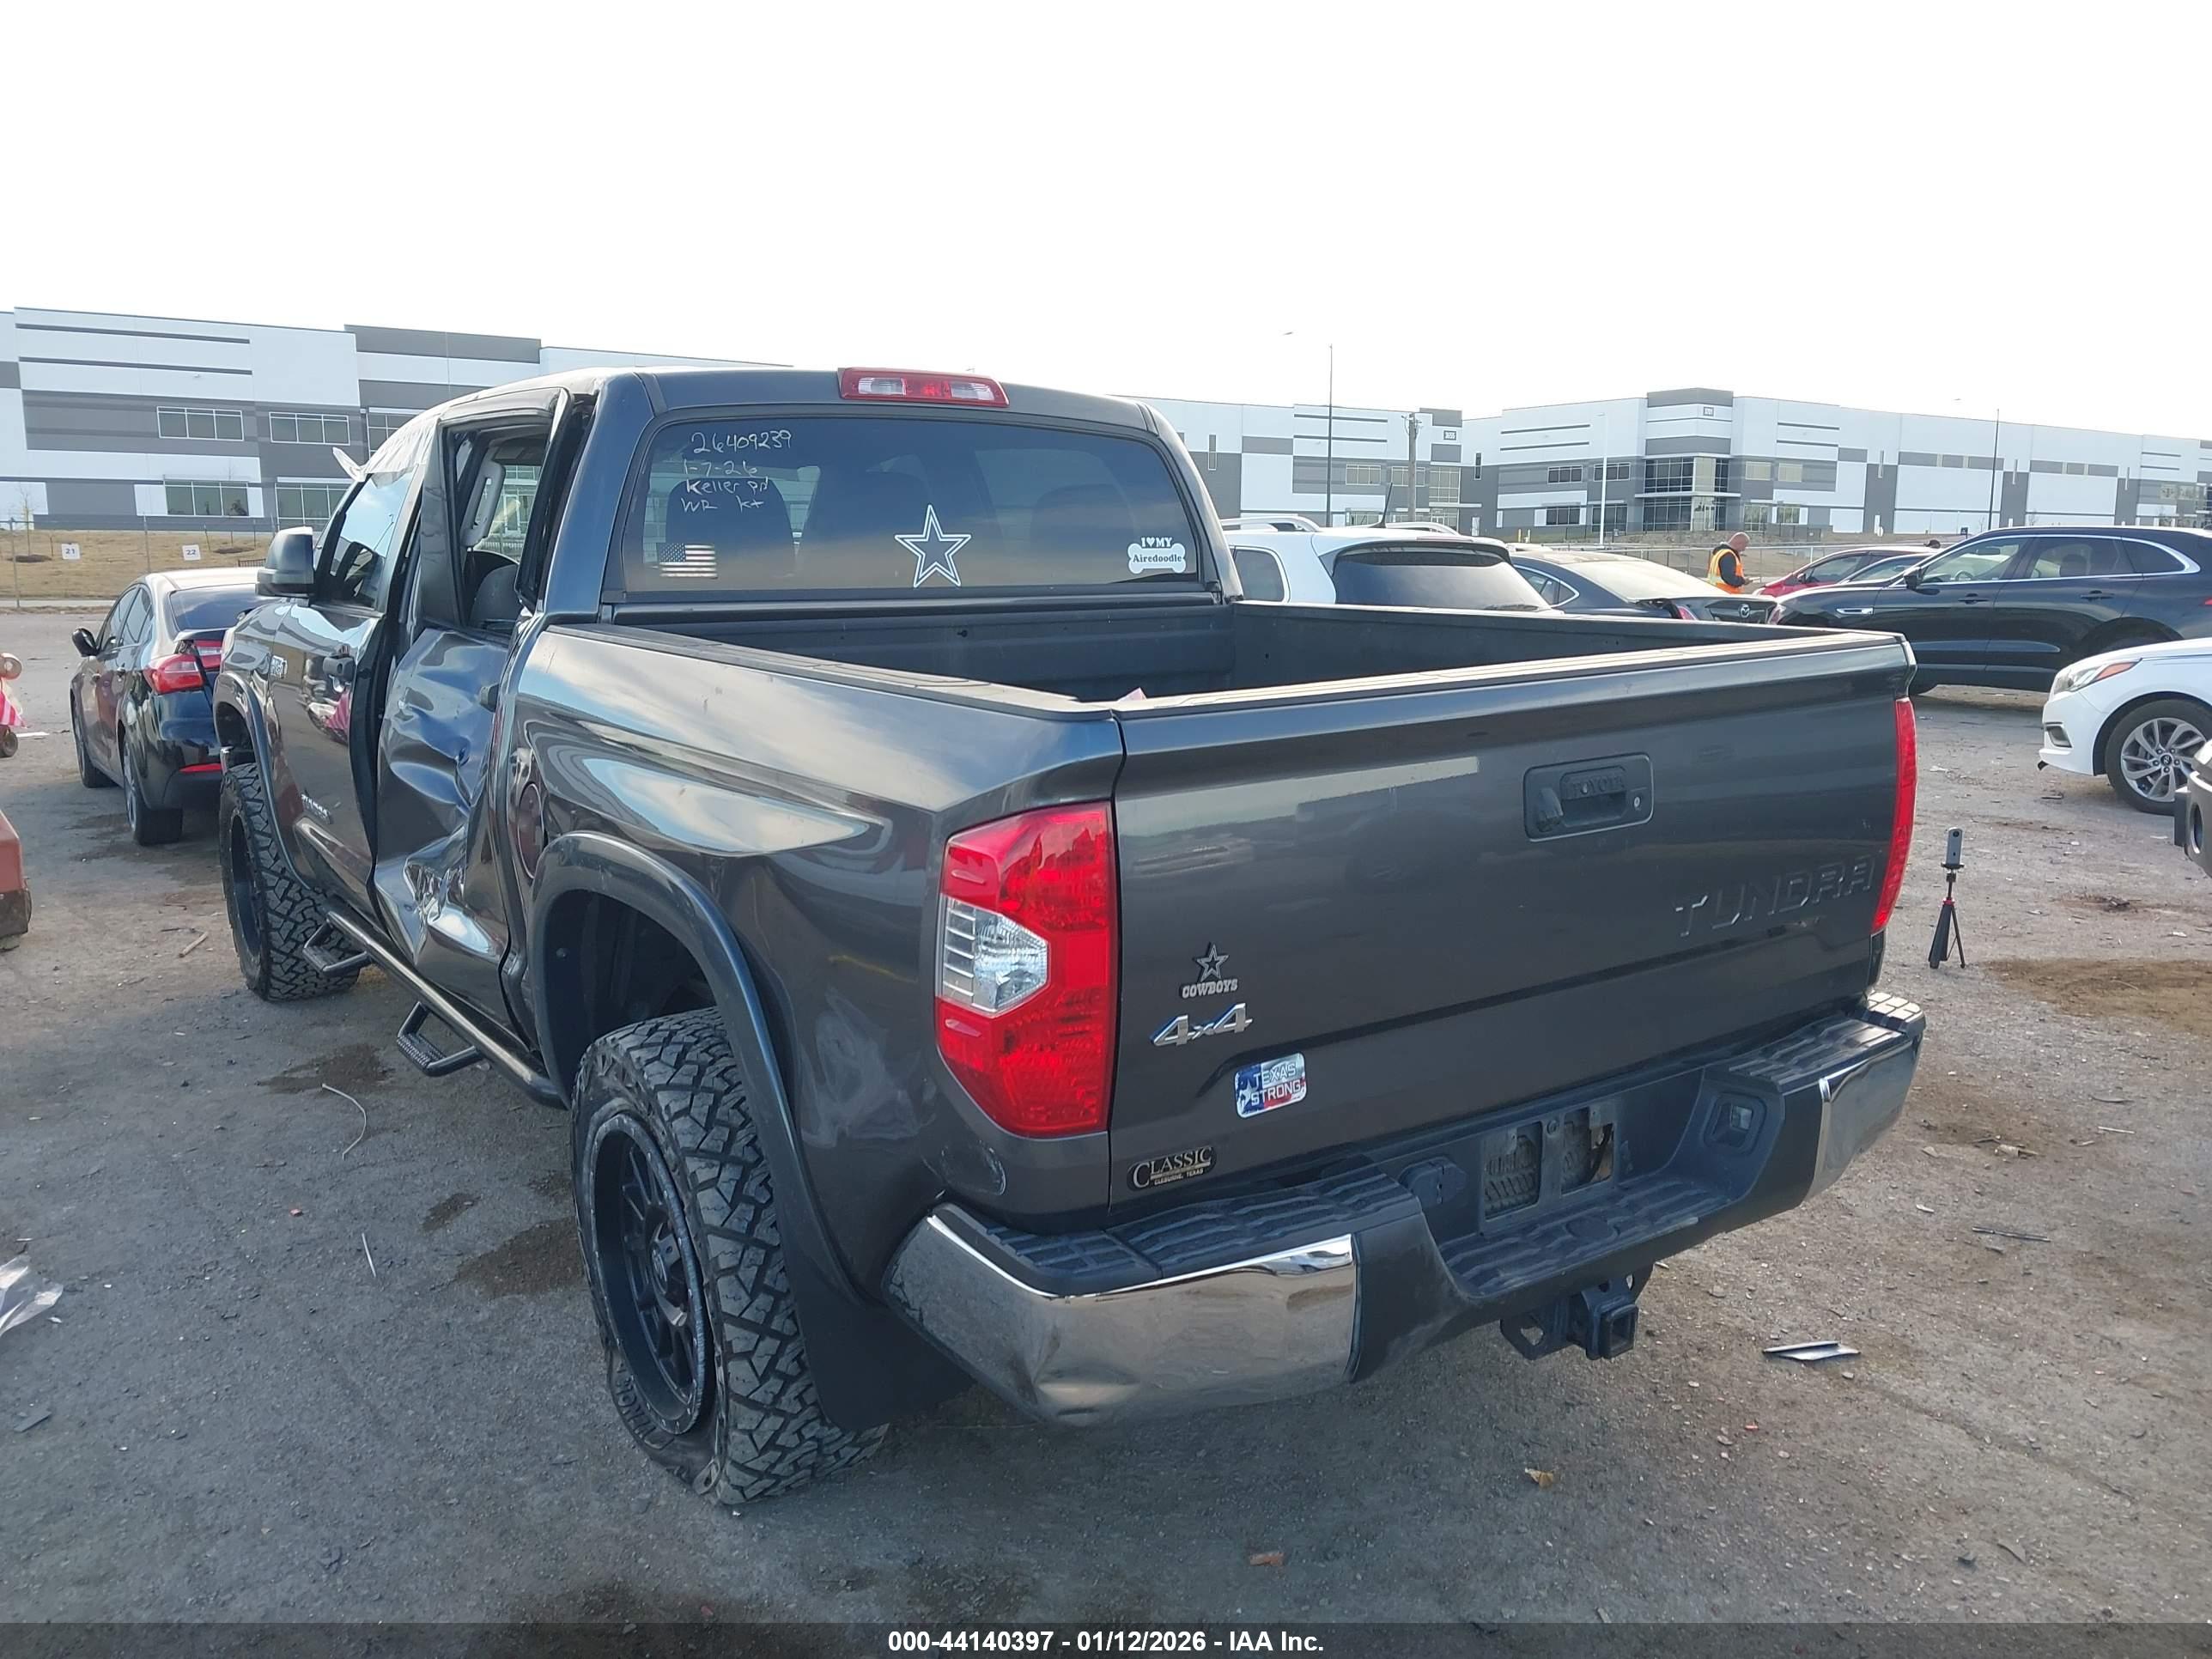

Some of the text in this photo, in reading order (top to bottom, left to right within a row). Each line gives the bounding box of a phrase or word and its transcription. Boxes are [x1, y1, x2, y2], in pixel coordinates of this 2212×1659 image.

[691, 429, 791, 453] 26409239
[1156, 537, 1173, 547] MY
[1133, 554, 1182, 562] Airedoodle
[1674, 854, 1876, 937] TUNDRA
[1182, 978, 1238, 999] COWBOYS
[1253, 1063, 1297, 1091] TEXAS
[1250, 1079, 1302, 1107] STRONG
[1133, 1146, 1212, 1188] CLASSIC
